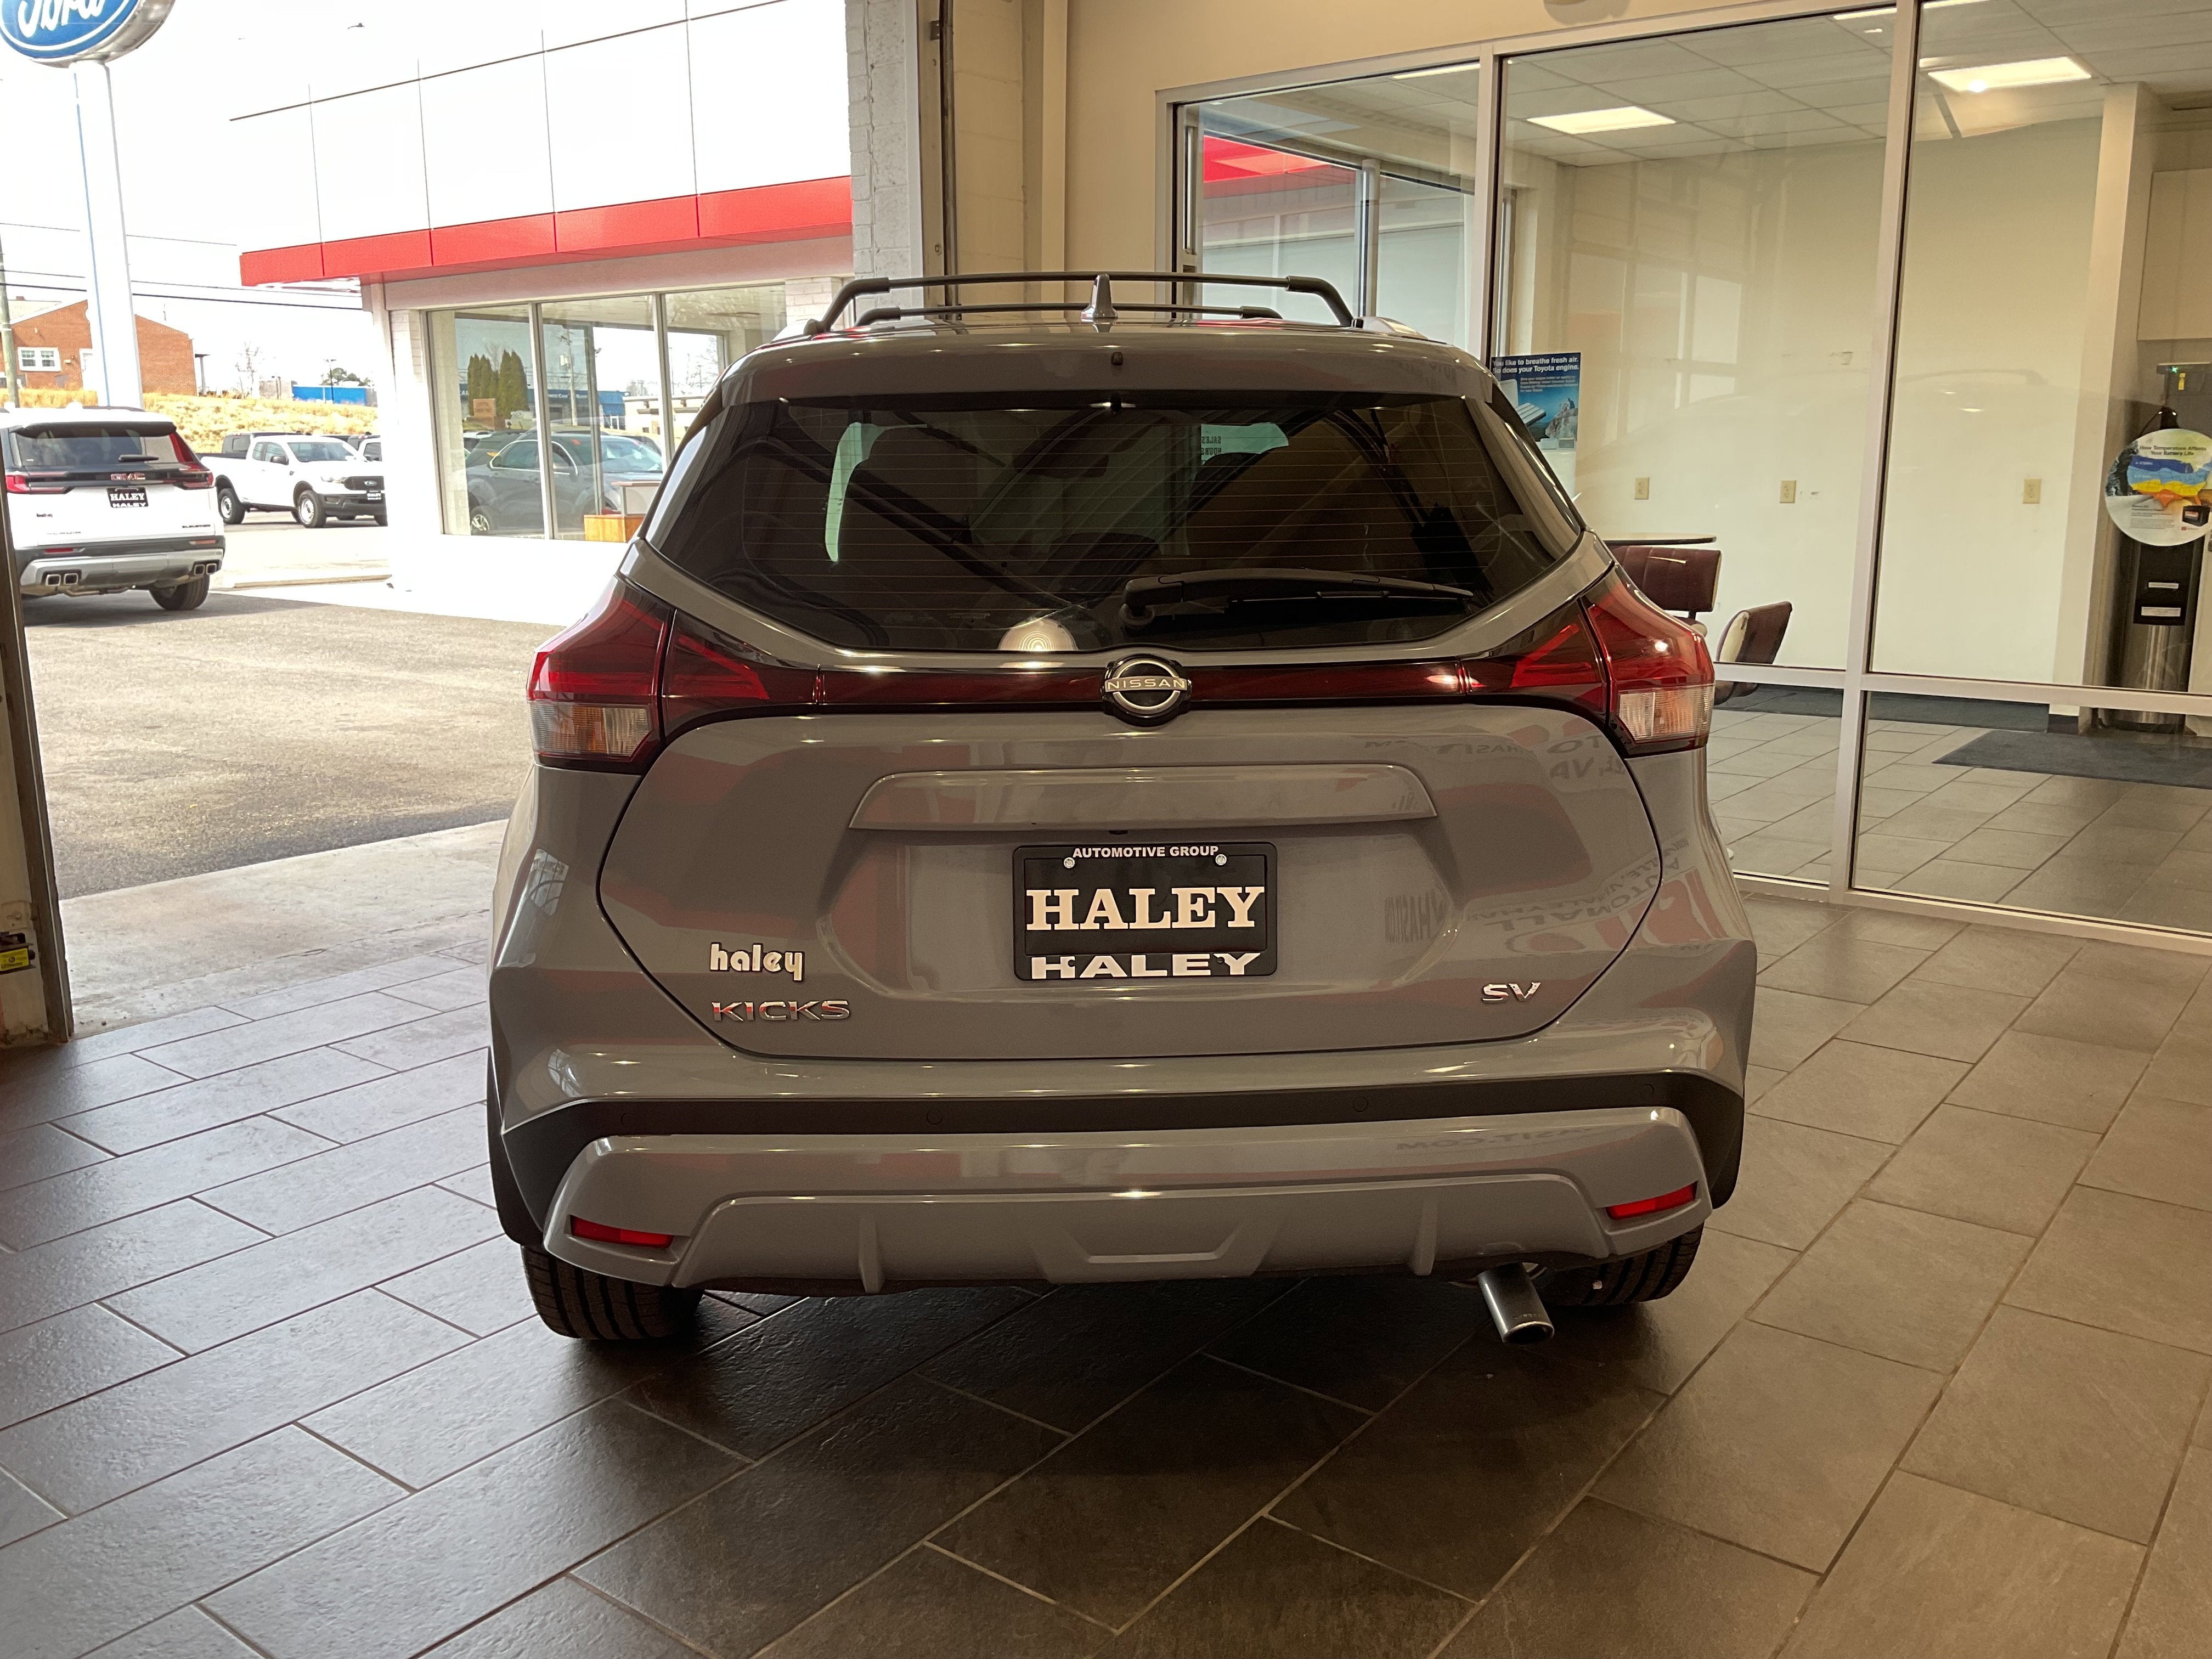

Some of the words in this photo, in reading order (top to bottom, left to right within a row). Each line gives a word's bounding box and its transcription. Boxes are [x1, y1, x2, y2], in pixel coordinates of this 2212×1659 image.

[110, 493, 145, 501] HALEY
[1108, 679, 1185, 690] NISSAN
[1073, 847, 1165, 858] AUTOMOTIVE
[1169, 845, 1219, 856] GROUP
[1026, 886, 1265, 930] HALEY
[710, 942, 804, 981] haley
[1031, 952, 1261, 979] HALEY
[1482, 981, 1541, 1003] SV
[712, 1000, 850, 1022] KICKS
